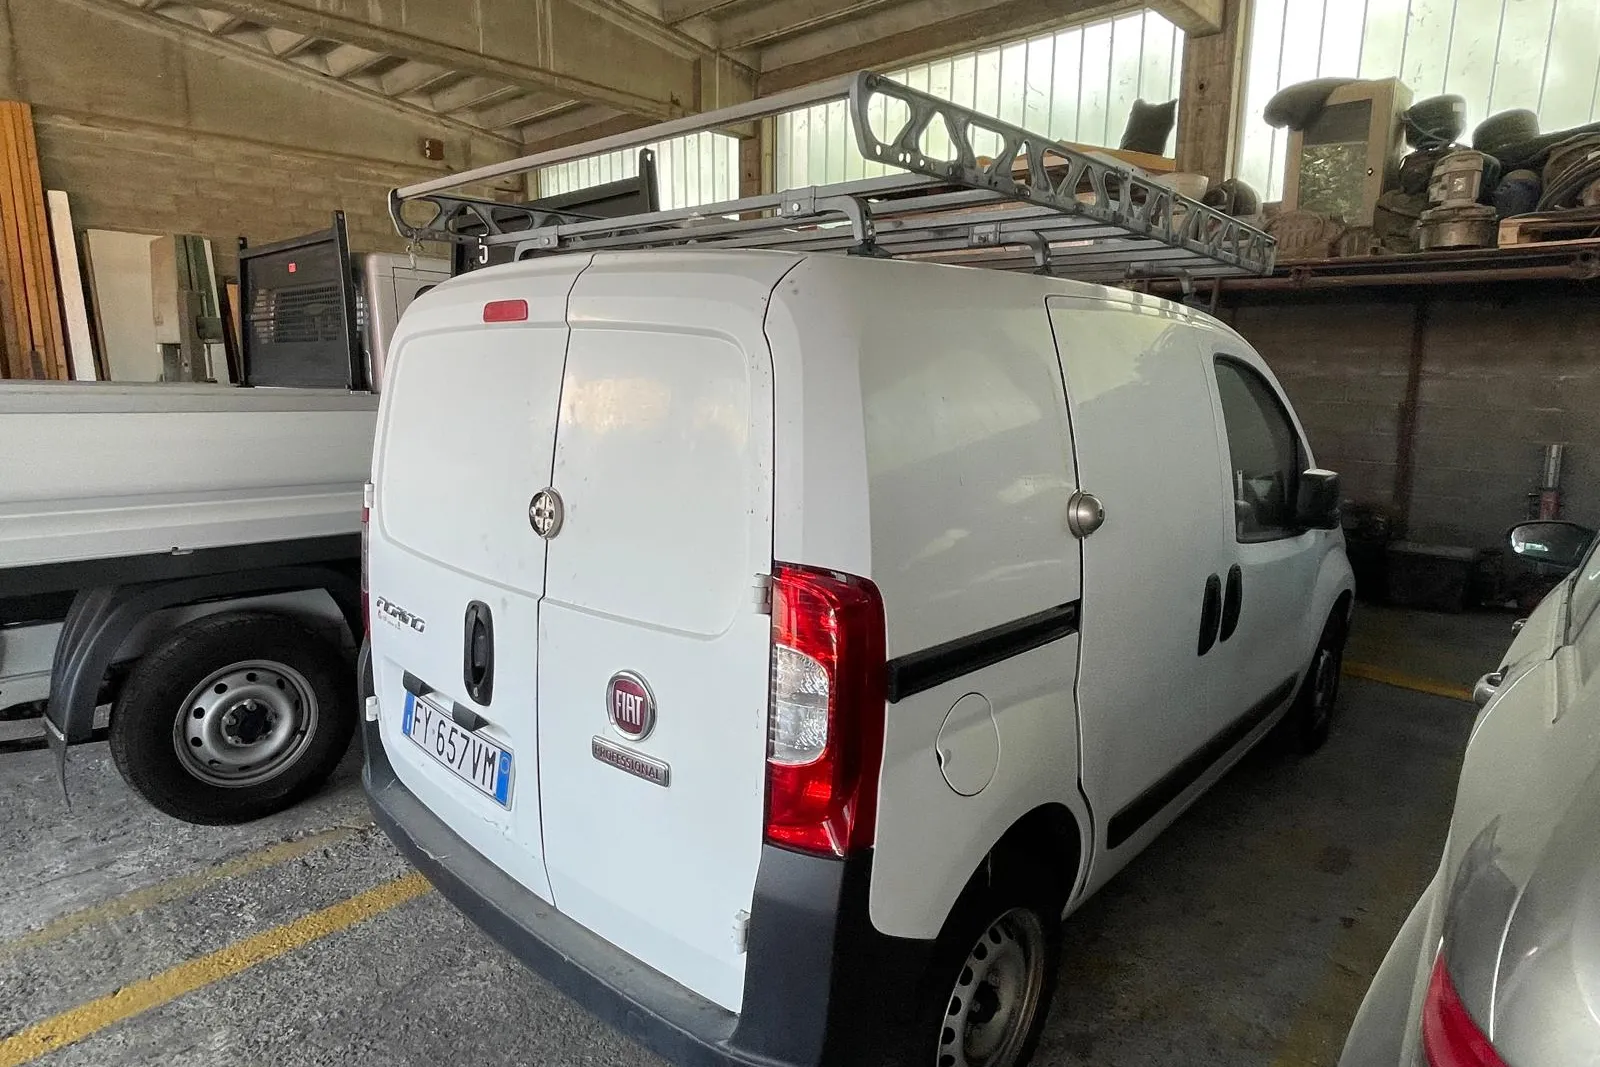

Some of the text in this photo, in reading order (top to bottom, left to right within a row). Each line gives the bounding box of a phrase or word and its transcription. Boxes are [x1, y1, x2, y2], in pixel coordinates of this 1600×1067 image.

[615, 689, 644, 726] FIAT
[412, 700, 497, 791] FY 657VM
[593, 744, 661, 780] PROFESSIONAL
